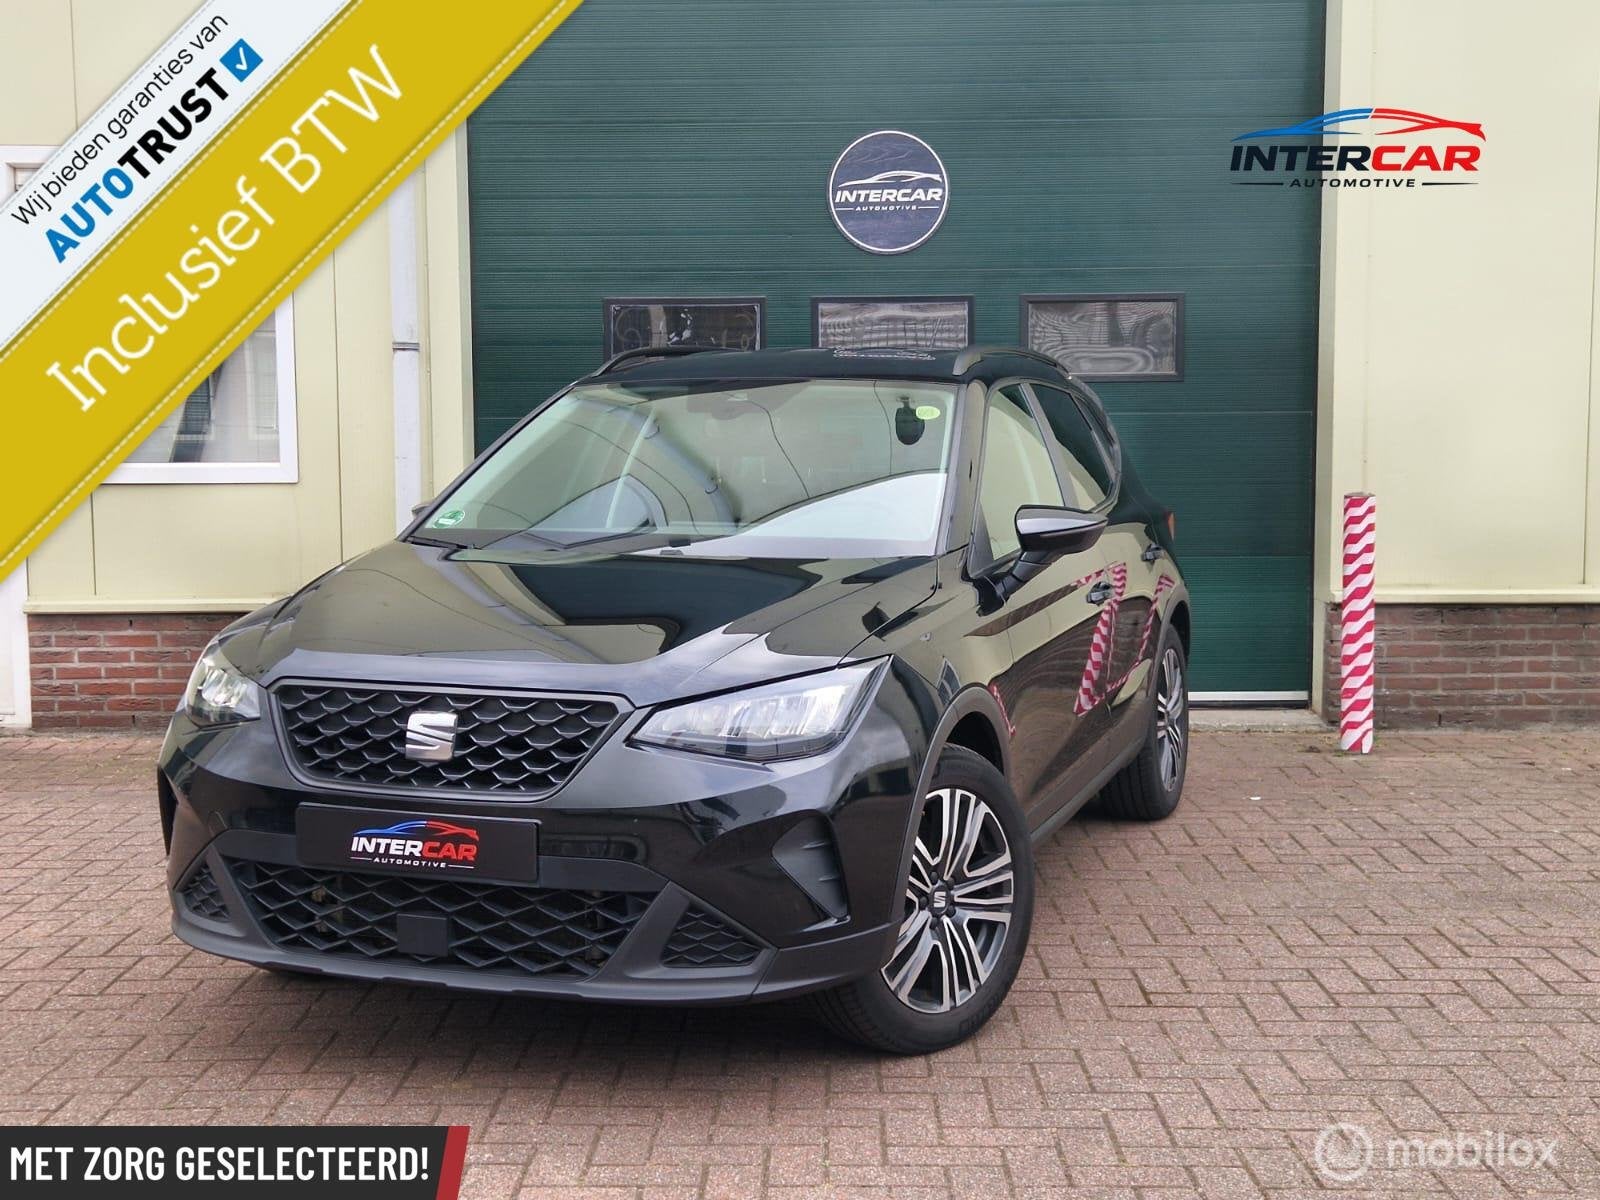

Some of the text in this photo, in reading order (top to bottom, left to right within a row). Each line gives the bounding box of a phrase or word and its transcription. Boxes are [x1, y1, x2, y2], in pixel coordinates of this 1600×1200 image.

[834, 188, 943, 203] INTERCAR
[351, 836, 478, 861] INTERCAR
[373, 857, 447, 868] AUTOMOTIVE
